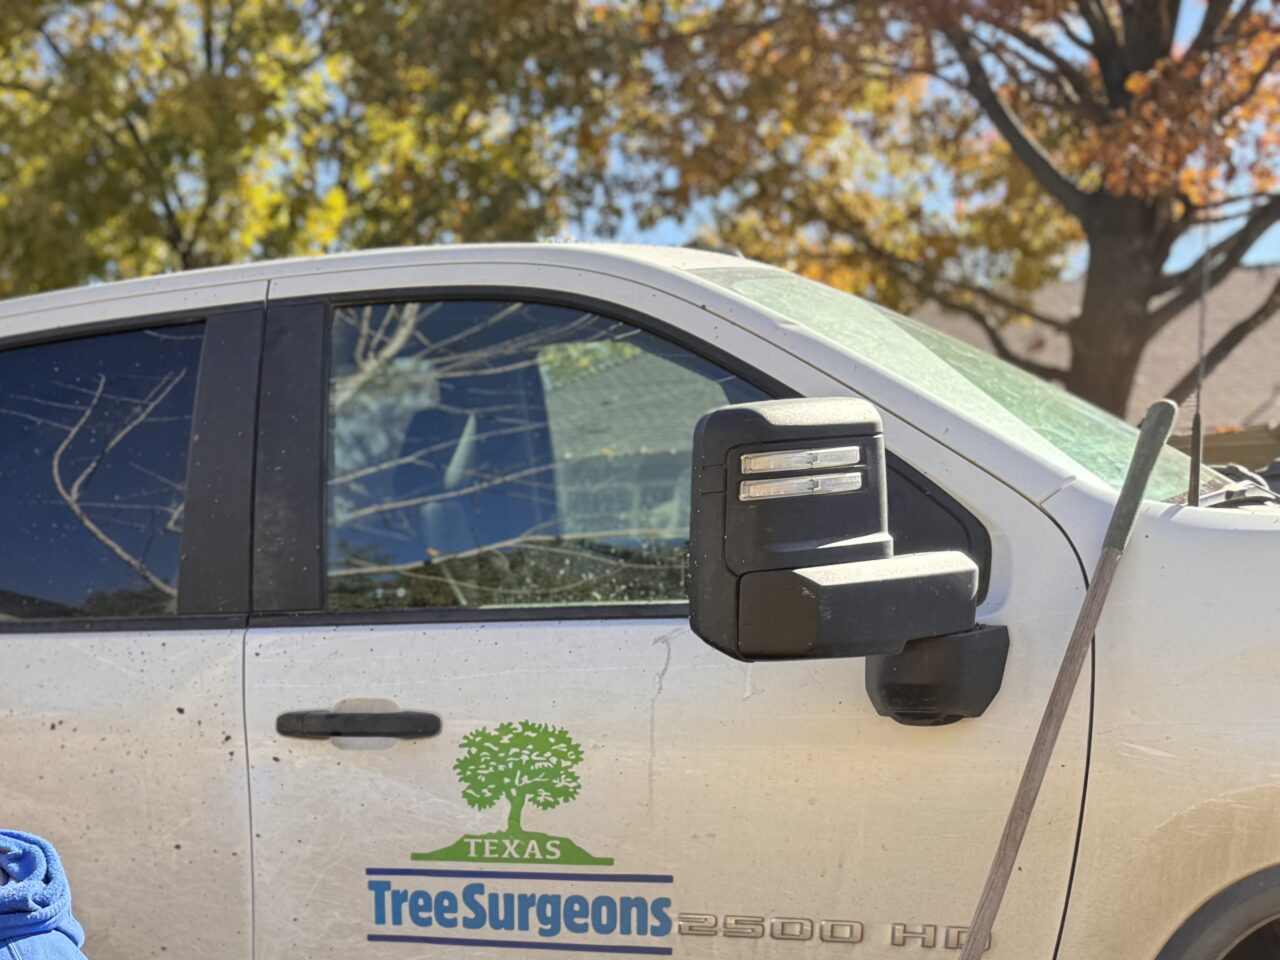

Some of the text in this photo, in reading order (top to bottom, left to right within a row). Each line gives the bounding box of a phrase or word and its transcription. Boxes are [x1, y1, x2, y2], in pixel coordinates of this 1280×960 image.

[463, 837, 562, 860] TEXAS
[367, 880, 673, 937] TreeSurgeons
[677, 912, 864, 943] 2500
